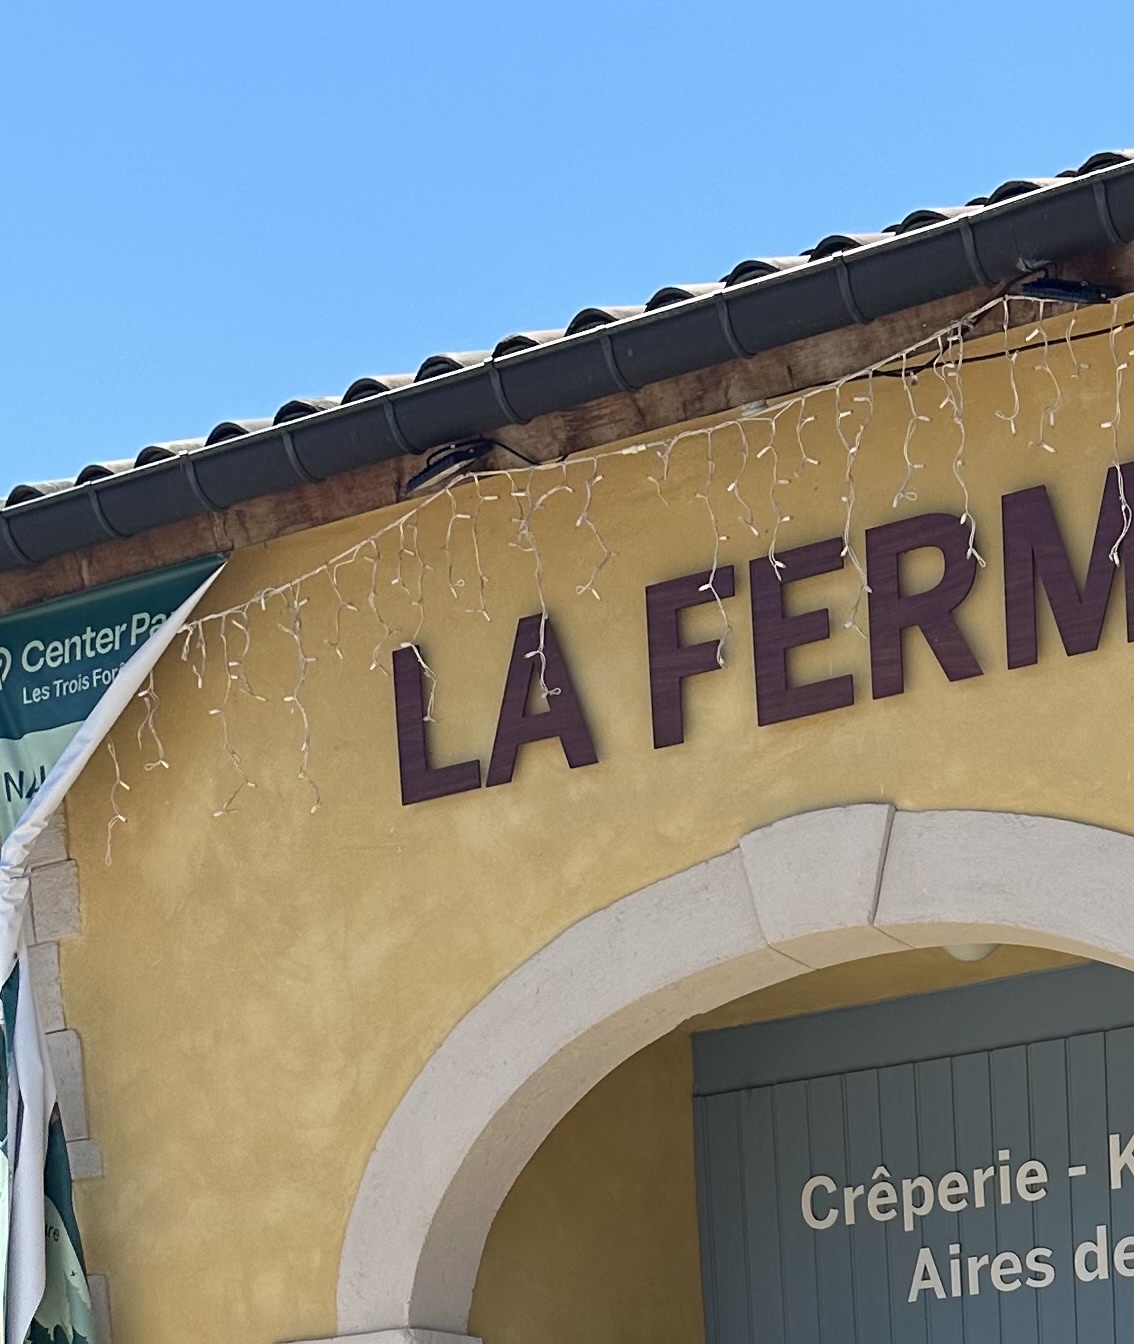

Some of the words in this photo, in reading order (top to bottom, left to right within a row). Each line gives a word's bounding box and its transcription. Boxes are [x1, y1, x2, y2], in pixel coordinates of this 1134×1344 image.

[21, 623, 127, 673] Center
[22, 685, 50, 705] Les
[53, 673, 90, 698] Trois
[392, 612, 599, 806] LA
[801, 1148, 1049, 1232] Crêperie
[1068, 1164, 1087, 1178] -
[907, 1243, 1056, 1303] Aires
